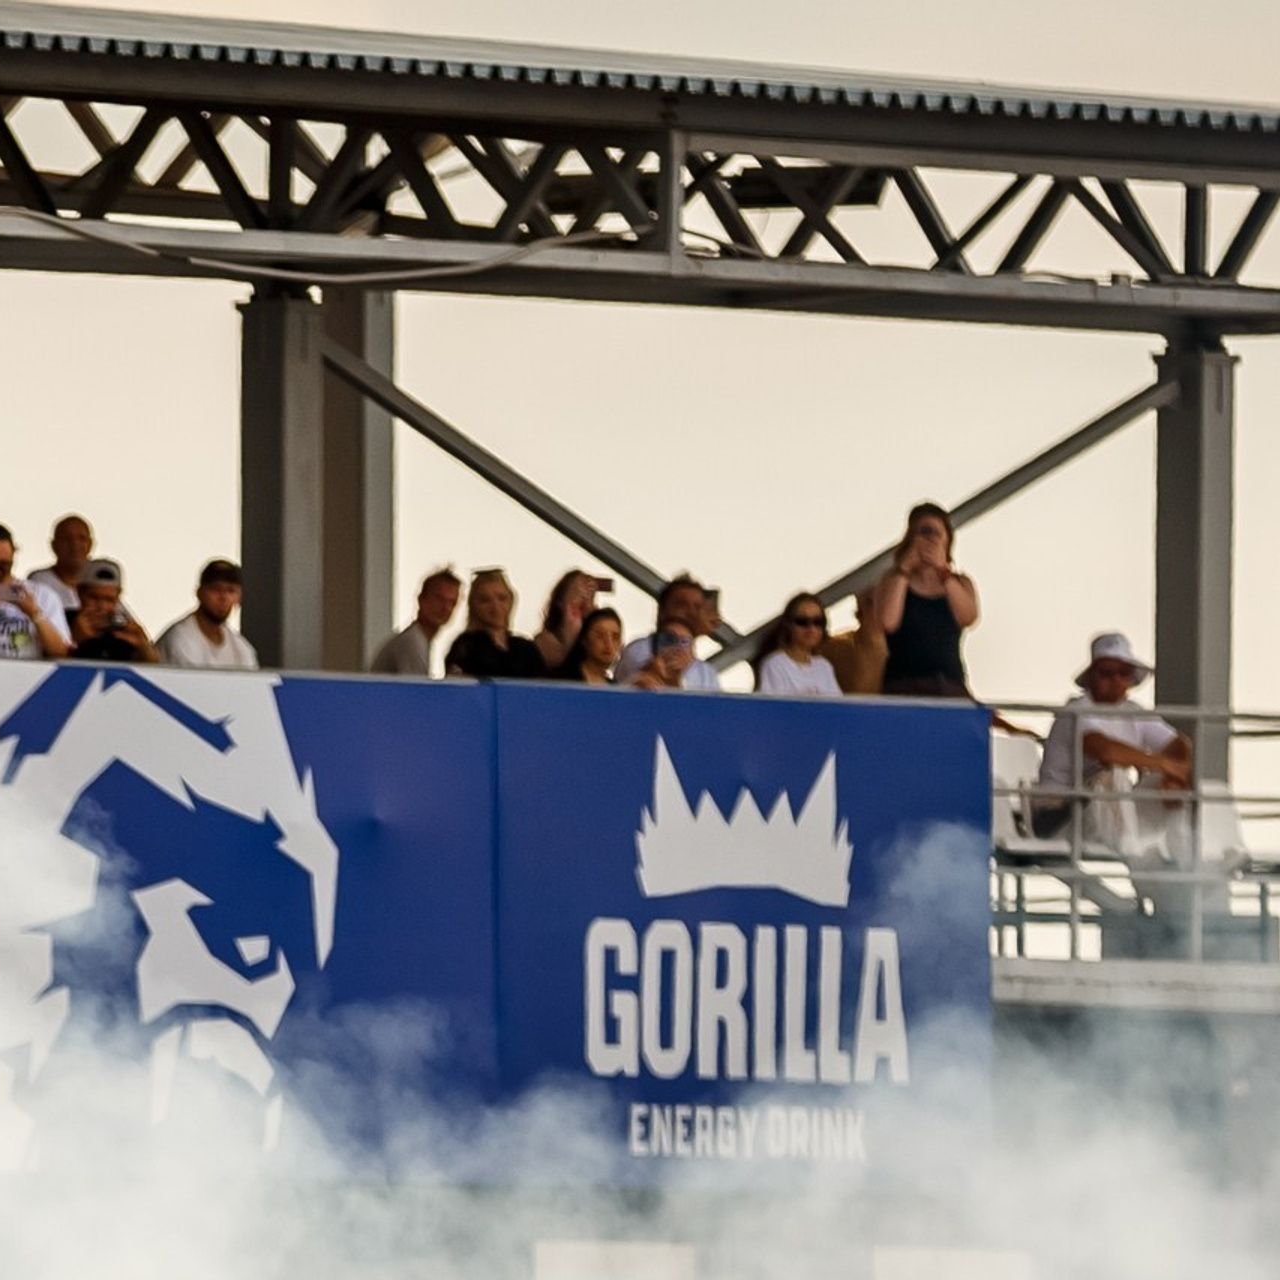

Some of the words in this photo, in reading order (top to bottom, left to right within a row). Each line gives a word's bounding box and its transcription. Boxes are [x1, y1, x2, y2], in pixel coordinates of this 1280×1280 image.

[584, 916, 909, 1085] GORILLA
[628, 1103, 756, 1159] ENERGY
[768, 1106, 867, 1160] DRINK
